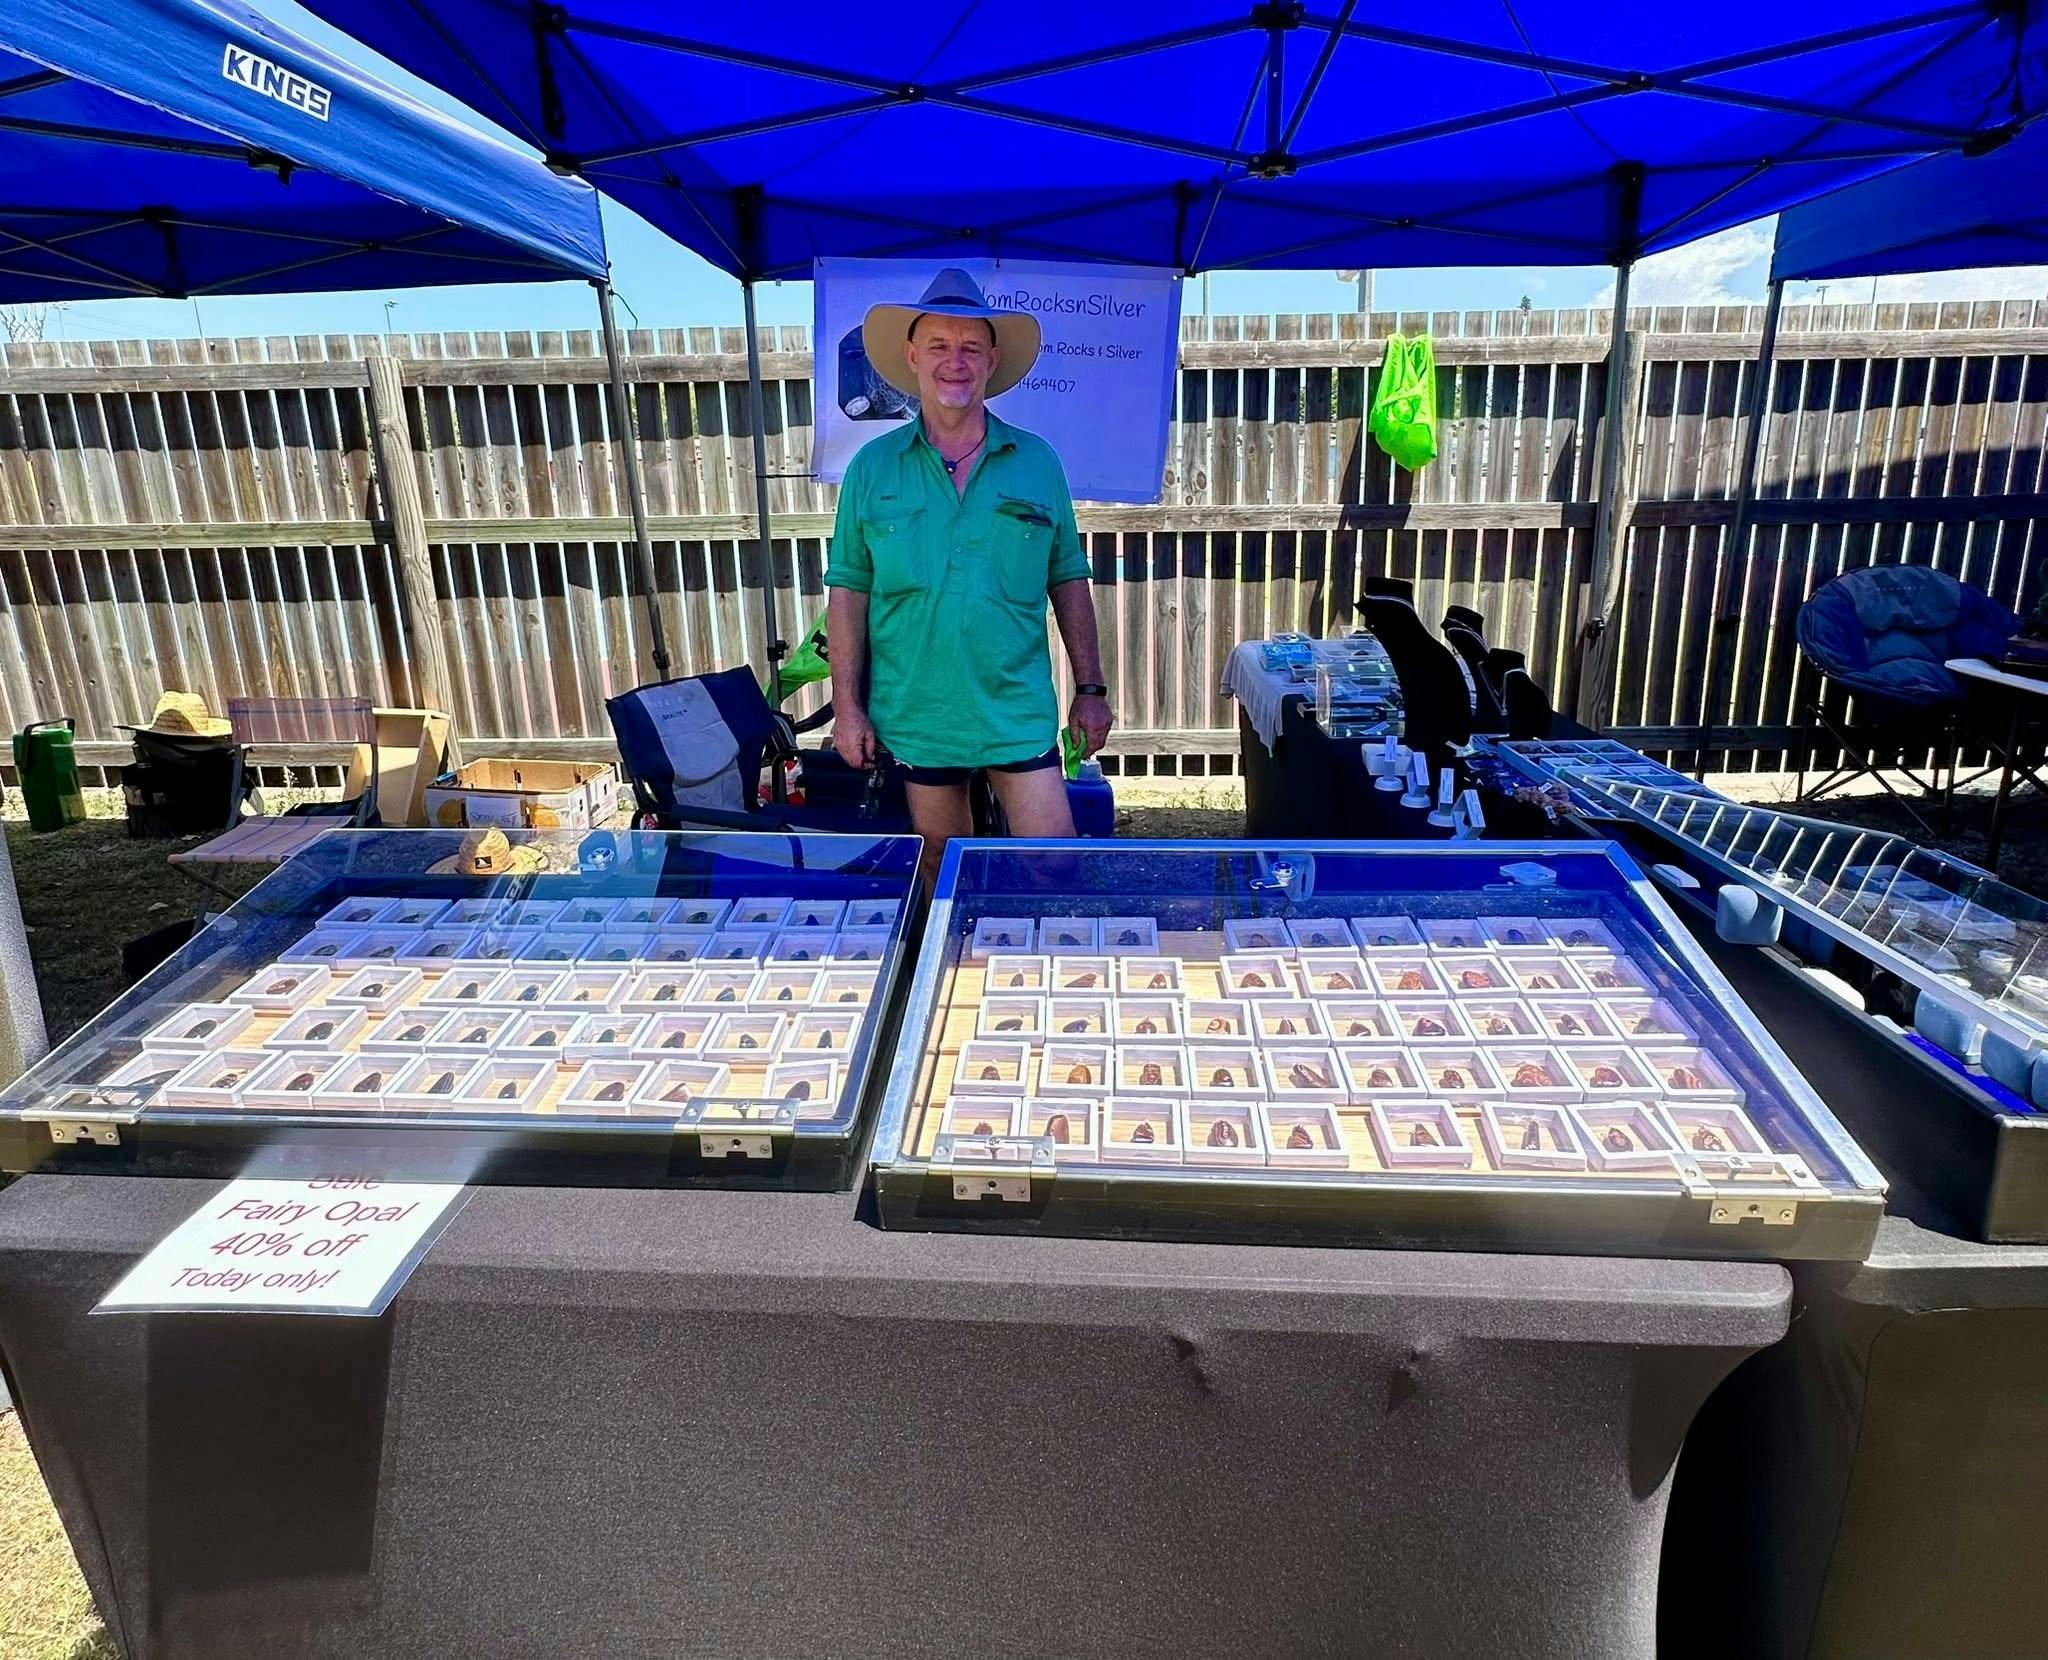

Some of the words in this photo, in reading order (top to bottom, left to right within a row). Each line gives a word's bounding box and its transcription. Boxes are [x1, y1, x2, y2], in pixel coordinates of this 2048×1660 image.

[227, 49, 328, 117] KINGS
[1056, 341, 1095, 357] Rocks
[1106, 344, 1143, 360] Silver
[217, 1199, 321, 1226] Fairy
[324, 1201, 420, 1227] Opal
[210, 1231, 304, 1257] 40%
[303, 1233, 370, 1257] off
[170, 1267, 262, 1293] Today
[262, 1268, 341, 1293] only!
